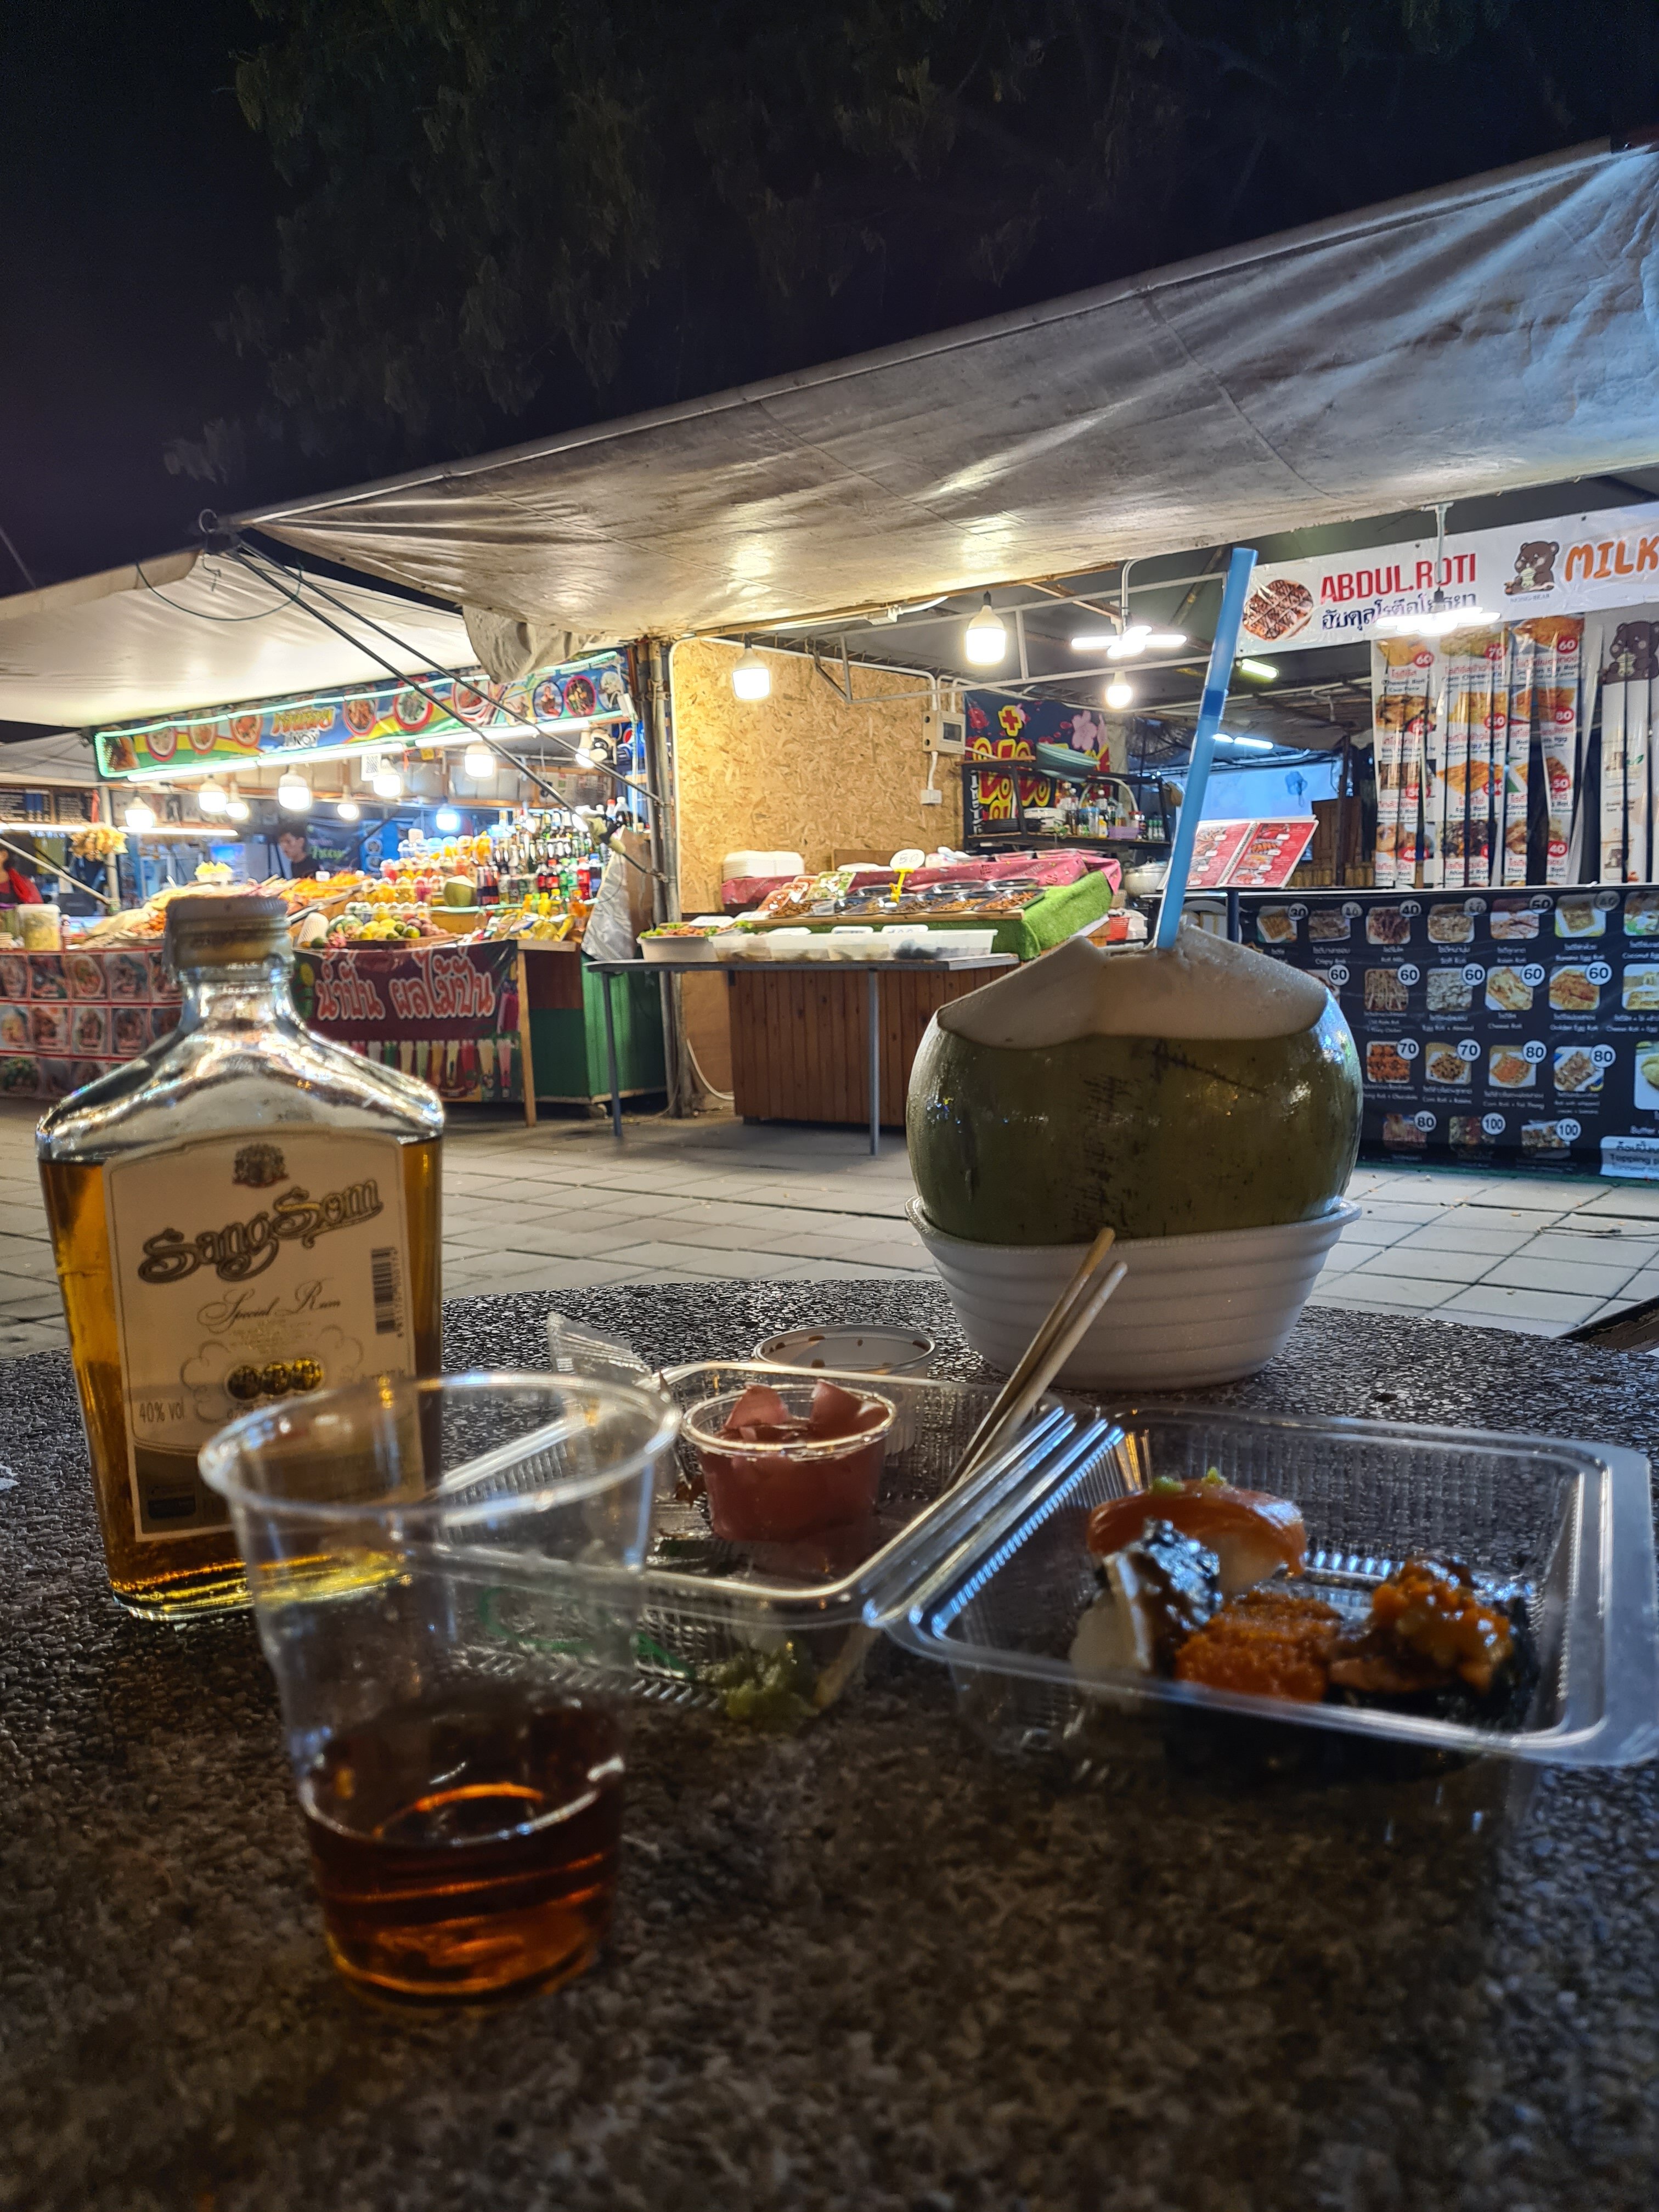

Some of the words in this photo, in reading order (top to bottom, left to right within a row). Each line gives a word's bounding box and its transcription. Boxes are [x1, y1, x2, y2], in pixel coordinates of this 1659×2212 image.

[1565, 535, 1659, 582] MILK
[1320, 553, 1477, 605] ABDUL.ROTI
[1559, 640, 1576, 651] 60
[1416, 654, 1432, 664] 60
[1291, 907, 1306, 917] 30
[1402, 905, 1419, 915] 40
[1331, 969, 1347, 980] 60
[1401, 969, 1417, 981] 60
[1465, 969, 1483, 980] 60
[1524, 968, 1542, 980] 60
[1589, 967, 1609, 979] 60
[1400, 1043, 1417, 1054] 70
[1460, 1045, 1478, 1056] 70
[1526, 1047, 1544, 1058] 80
[1594, 1051, 1613, 1062] 80
[1418, 1116, 1434, 1127] 80
[1485, 1118, 1503, 1130] 100
[1559, 1124, 1578, 1136] 100
[196, 1288, 280, 1334] Special
[275, 1277, 341, 1317] Rum
[139, 1401, 165, 1423] 40%
